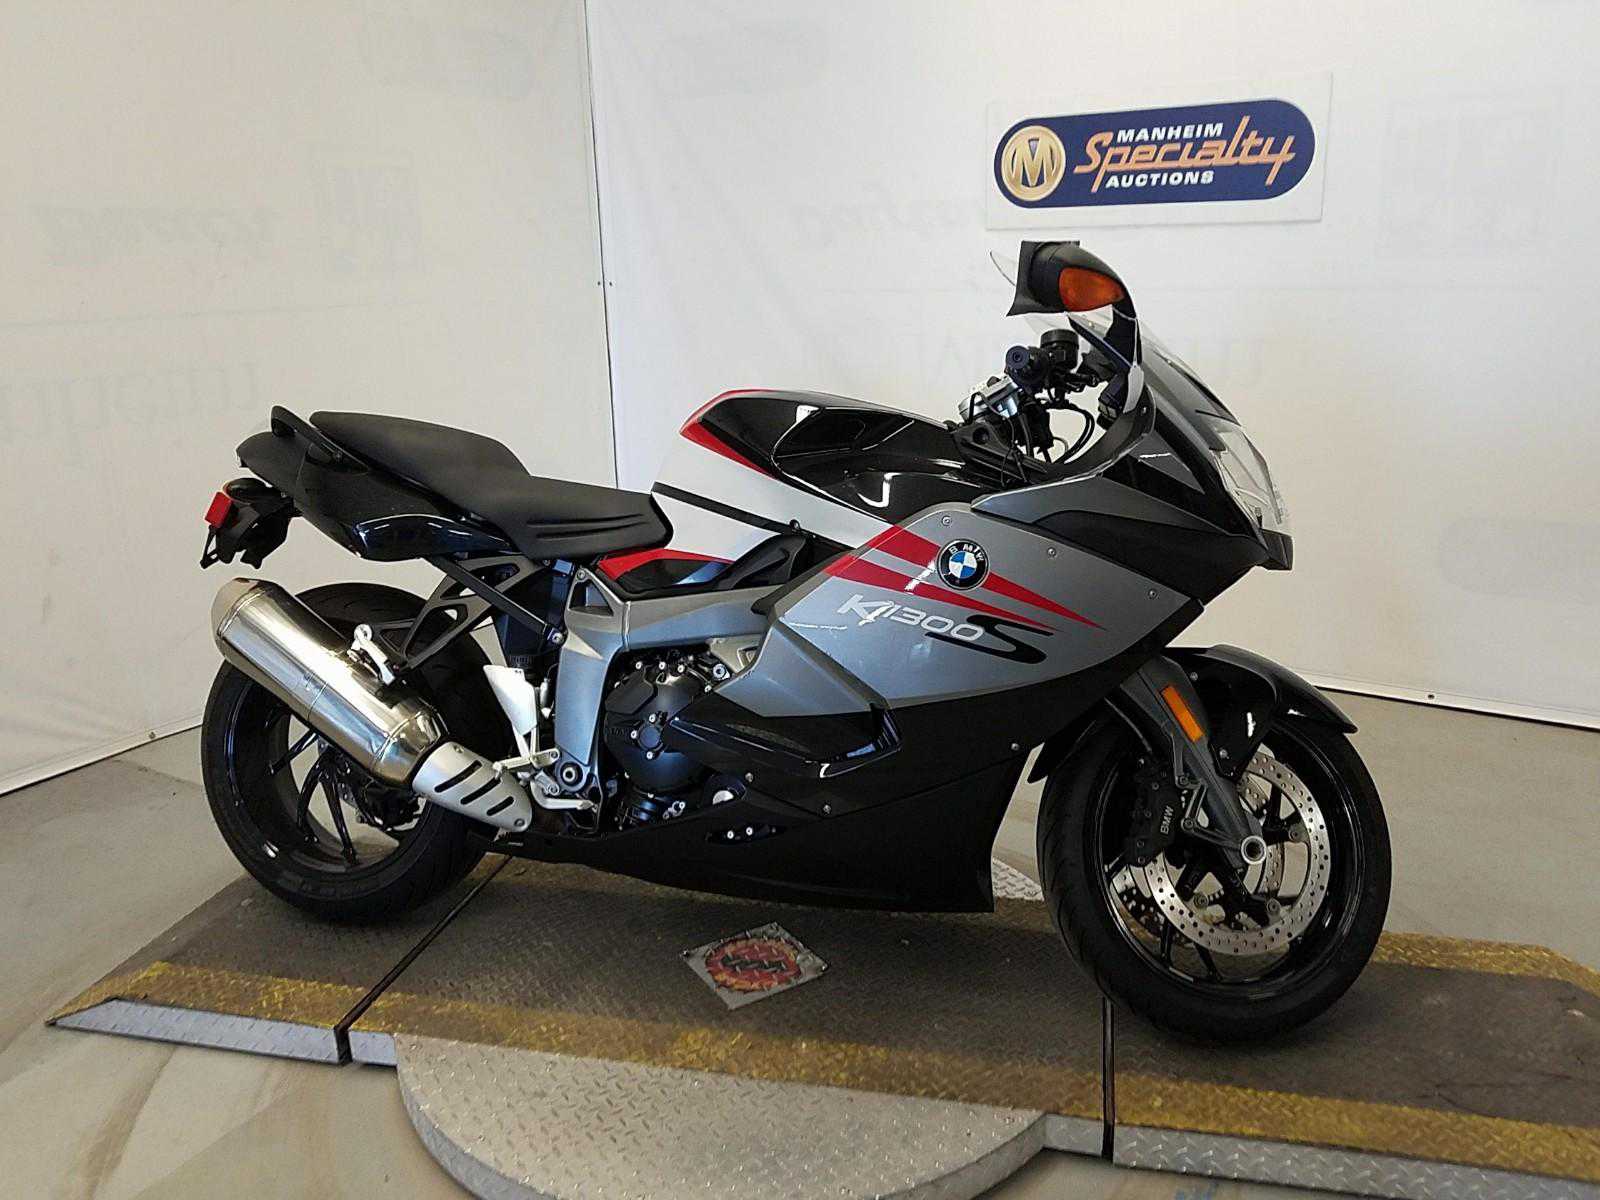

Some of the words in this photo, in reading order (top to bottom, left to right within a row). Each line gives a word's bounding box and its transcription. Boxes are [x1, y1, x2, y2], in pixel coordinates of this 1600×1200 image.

[1117, 122, 1223, 143] MANHEIM
[1008, 136, 1058, 189] M
[1073, 115, 1295, 193] Specialty
[1105, 170, 1215, 188] AUCTIONS
[949, 543, 985, 561] BMW
[1160, 805, 1174, 835] BMW
